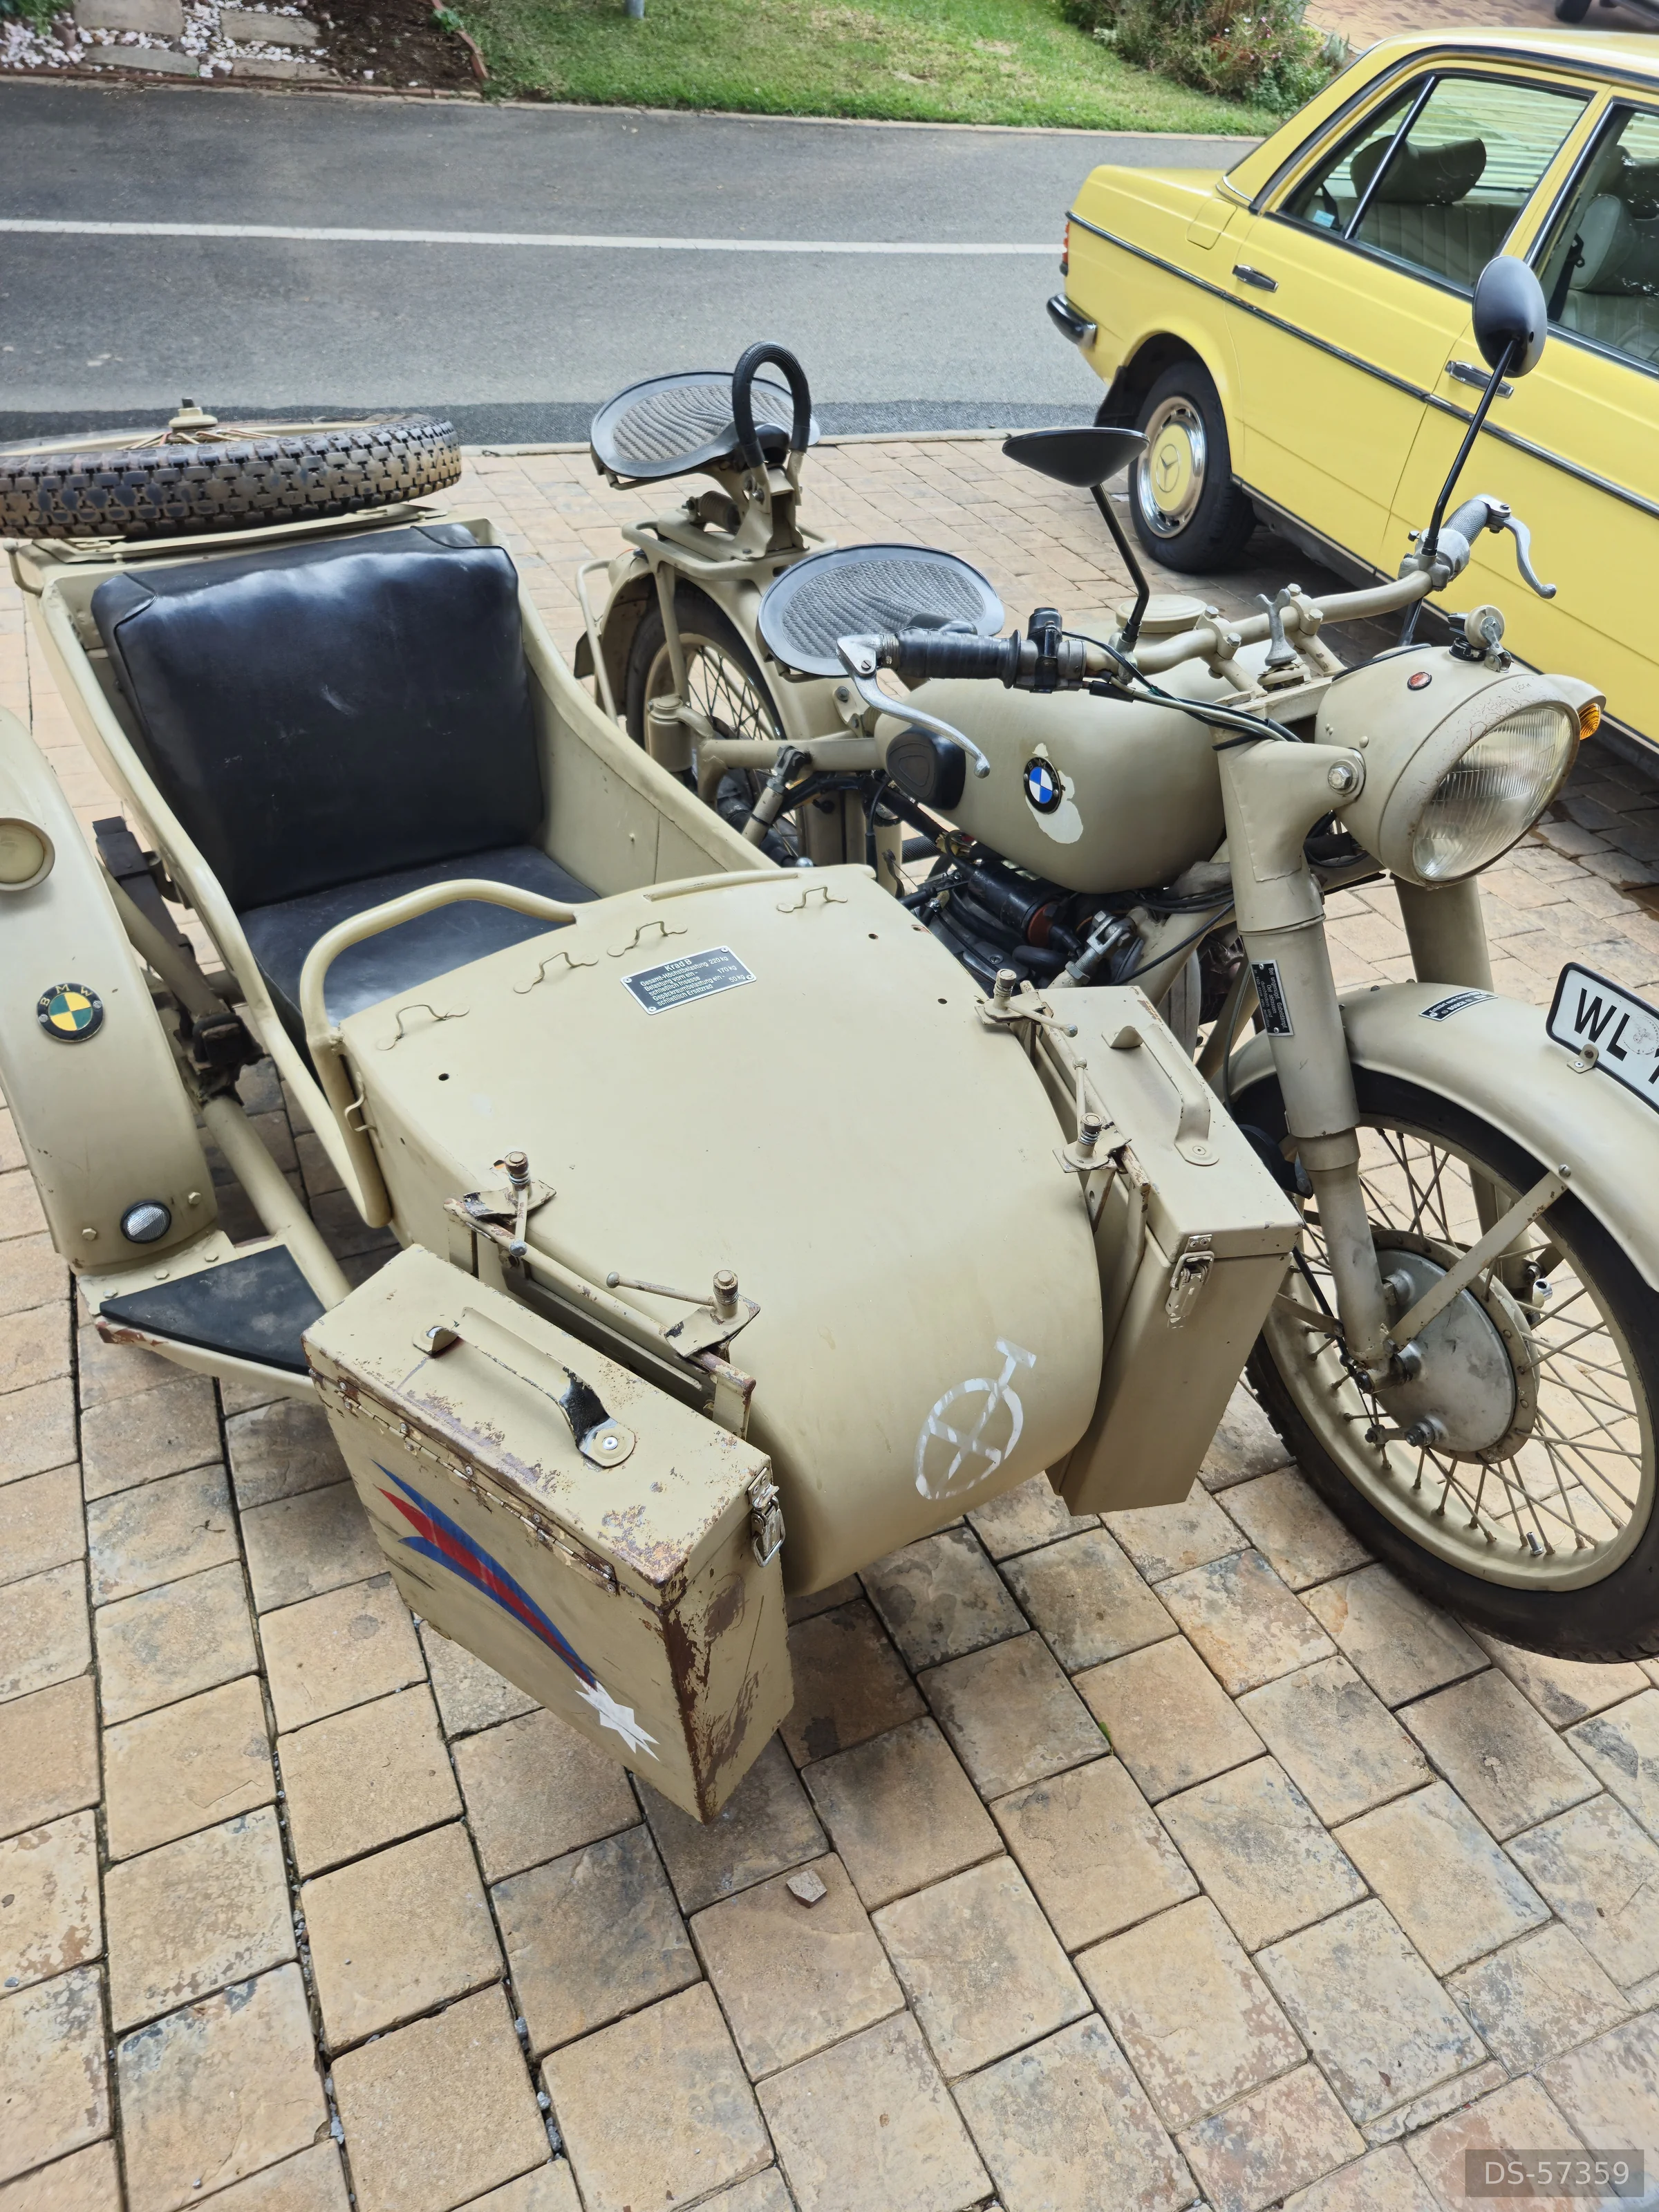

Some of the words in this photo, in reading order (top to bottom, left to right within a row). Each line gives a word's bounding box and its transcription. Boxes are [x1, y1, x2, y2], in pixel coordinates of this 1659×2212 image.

[1028, 759, 1058, 783] BMW
[664, 961, 685, 971] Krad
[644, 980, 673, 991] Belastung
[686, 984, 713, 995] Ersatzrad
[40, 984, 93, 1007] BMW
[1574, 988, 1630, 1061] WL
